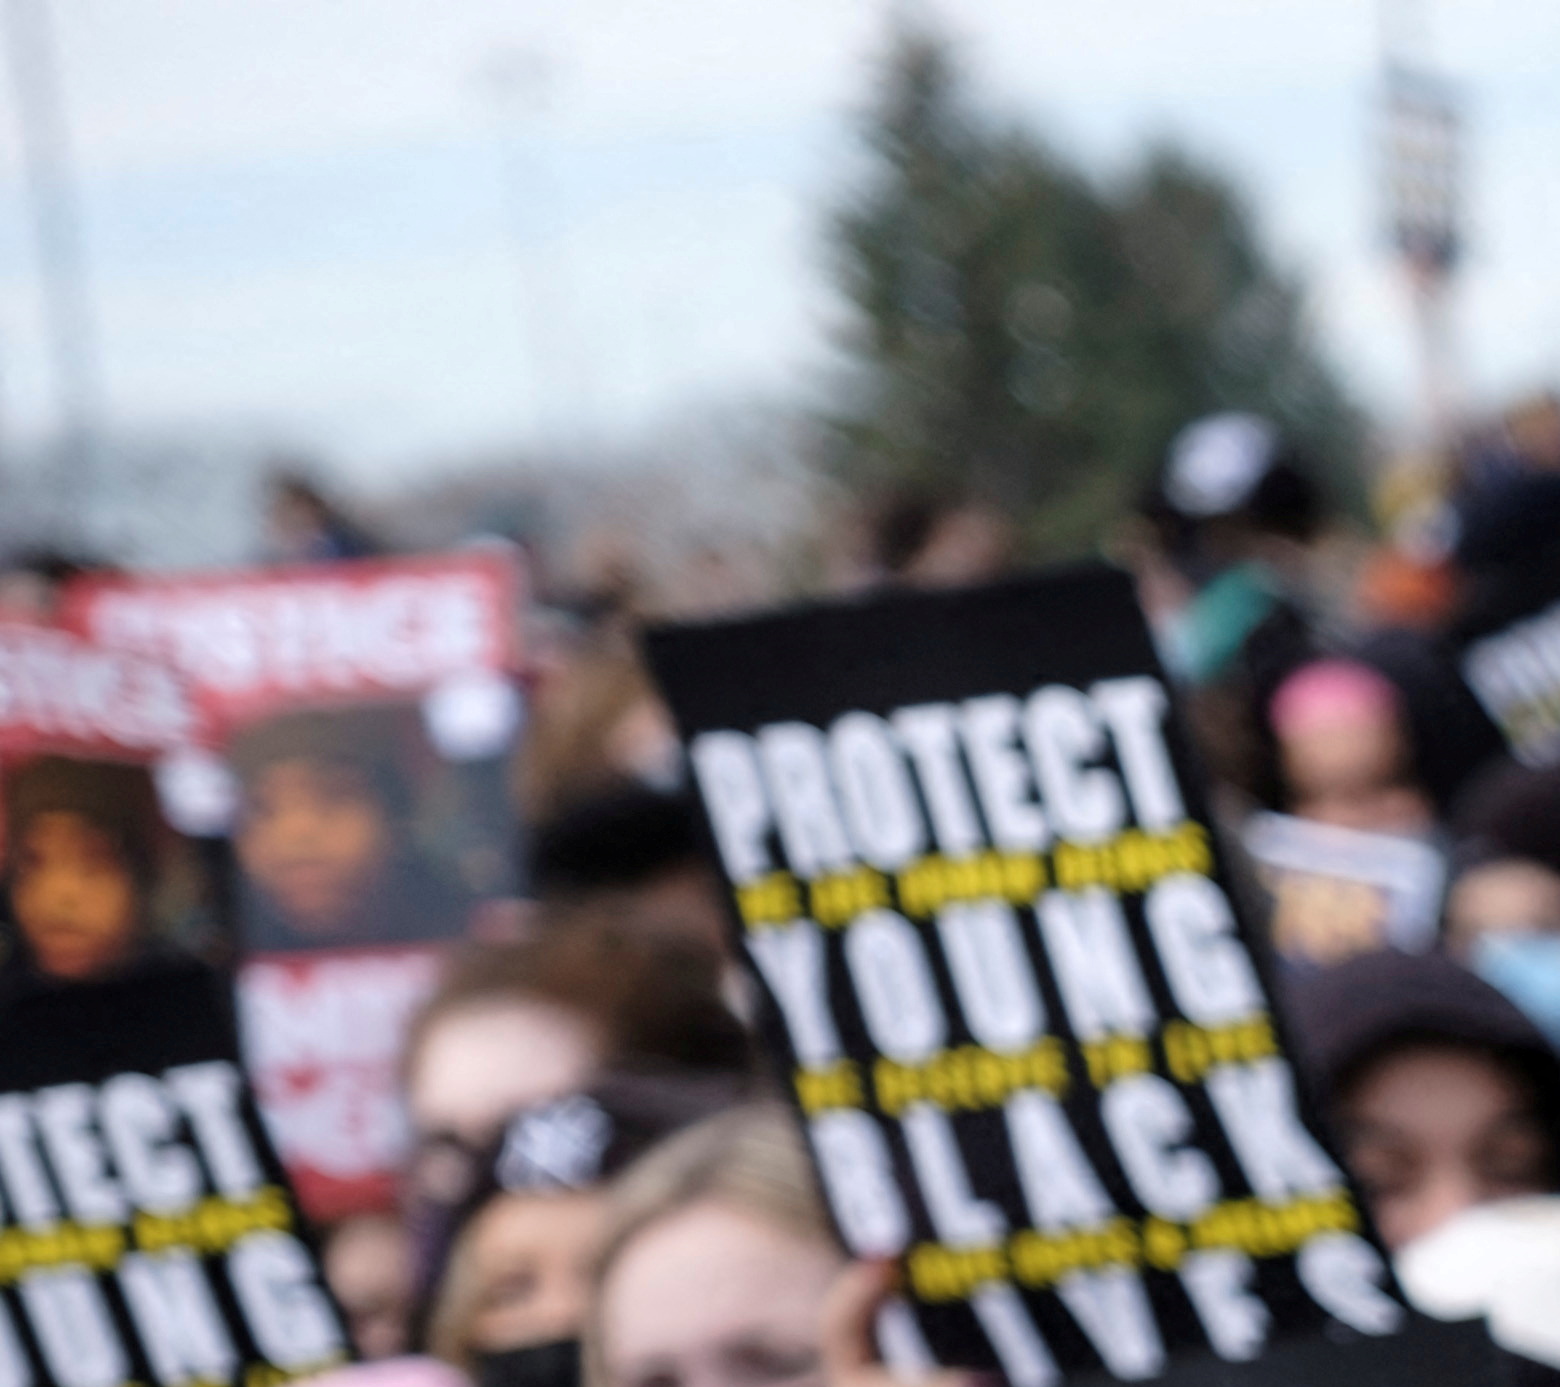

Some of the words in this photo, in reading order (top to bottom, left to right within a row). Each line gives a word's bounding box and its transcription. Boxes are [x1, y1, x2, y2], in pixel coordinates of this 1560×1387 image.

[690, 674, 1190, 884] PROTECT
[745, 872, 1268, 1068] YOUNG
[0, 1058, 265, 1238] TECT
[810, 1055, 1346, 1262] BLACK
